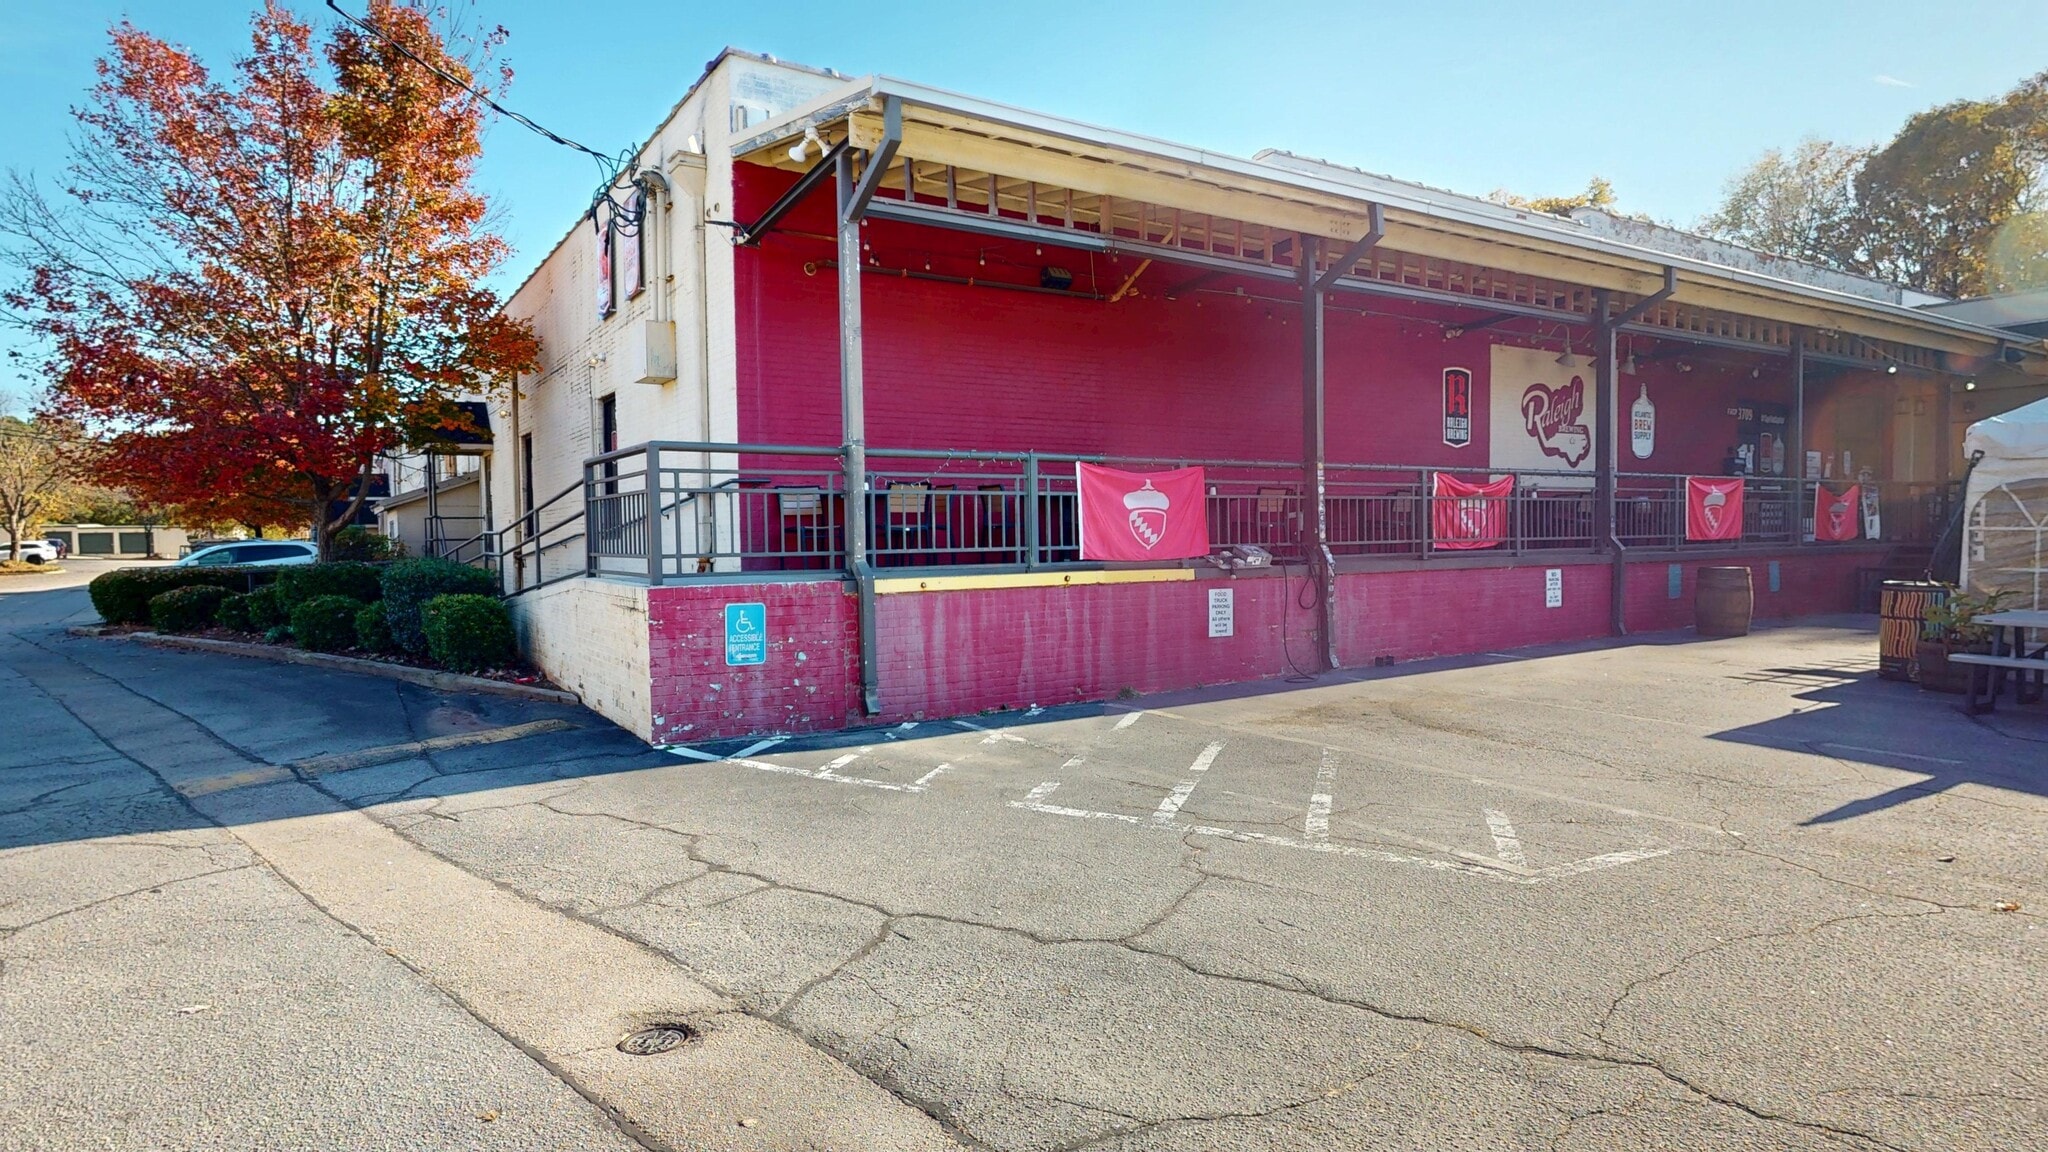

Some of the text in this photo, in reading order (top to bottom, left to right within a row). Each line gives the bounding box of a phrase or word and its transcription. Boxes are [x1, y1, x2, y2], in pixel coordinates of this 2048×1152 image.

[1447, 374, 1467, 415] R
[1522, 383, 1580, 430] Raleigh
[1738, 409, 1753, 421] 3709
[1446, 416, 1467, 428] RALEIGH
[1634, 419, 1651, 430] BREW
[1446, 428, 1467, 440] BREWING
[1558, 425, 1584, 433] BREWING
[1634, 431, 1651, 440] SUPPLY
[730, 633, 763, 642] ACCESSIBLE
[729, 643, 760, 651] ENTRANCE
